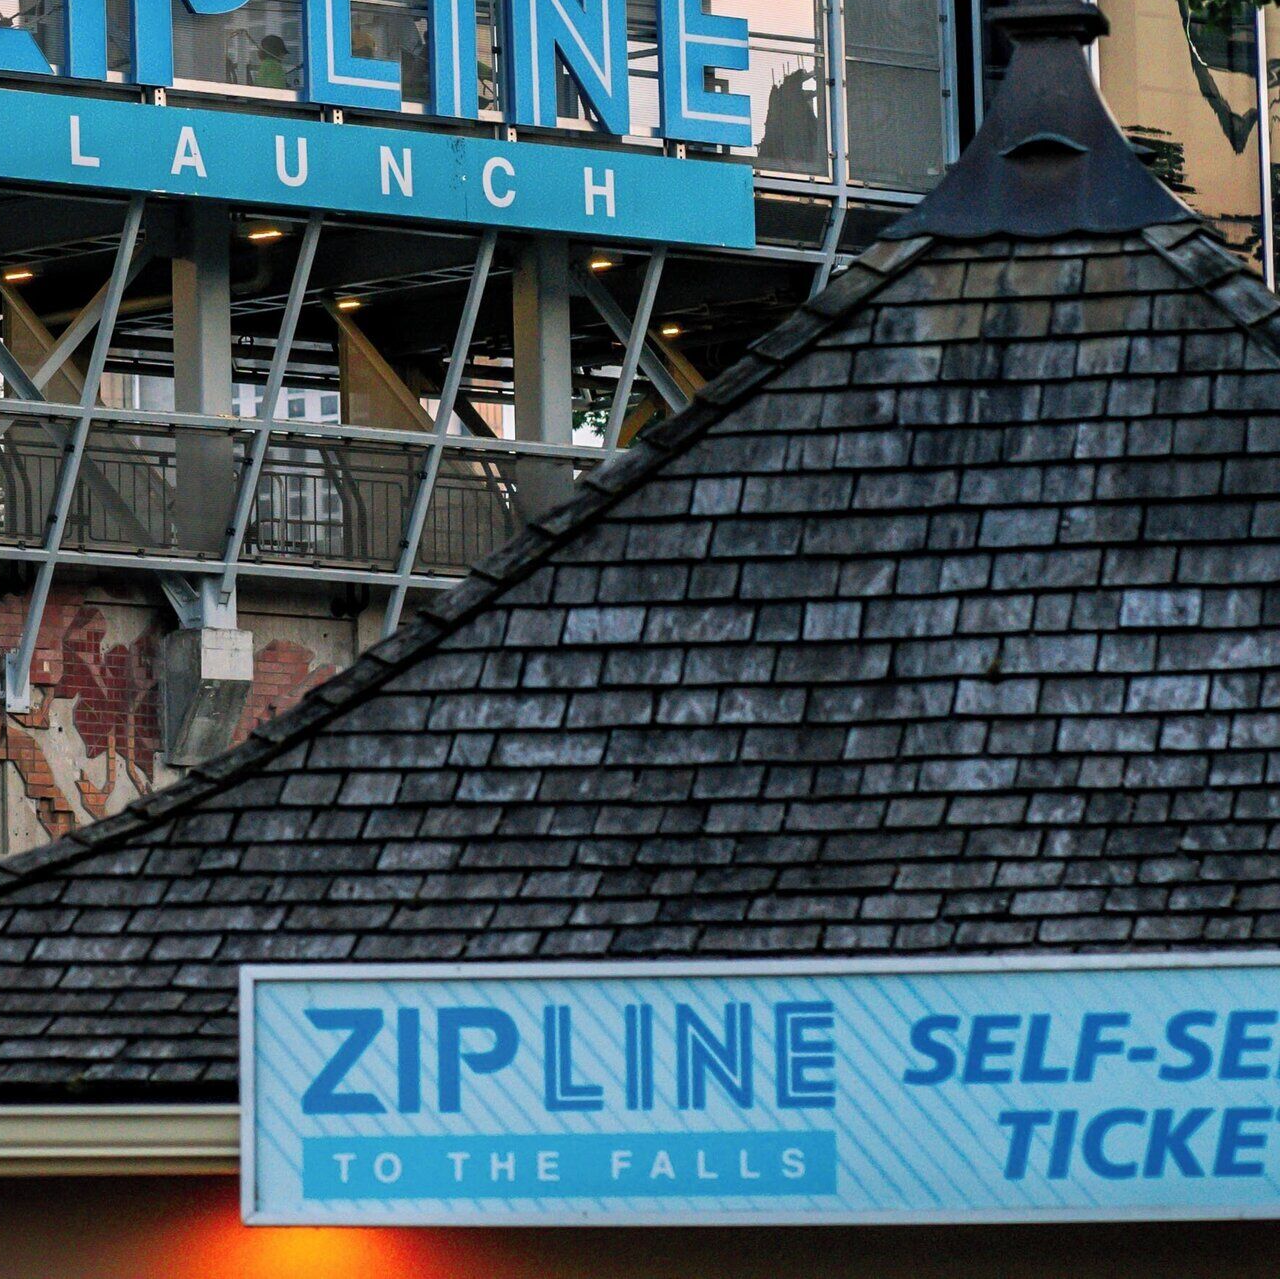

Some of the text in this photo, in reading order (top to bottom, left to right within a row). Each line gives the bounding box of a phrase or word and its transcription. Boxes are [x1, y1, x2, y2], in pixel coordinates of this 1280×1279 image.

[68, 114, 617, 219] LAUNCH
[302, 1000, 837, 1115] ZIPLINE
[903, 1009, 1280, 1085] SELF-SE
[333, 1147, 808, 1184] TO THE FALLS
[997, 1105, 1280, 1182] TICKE
